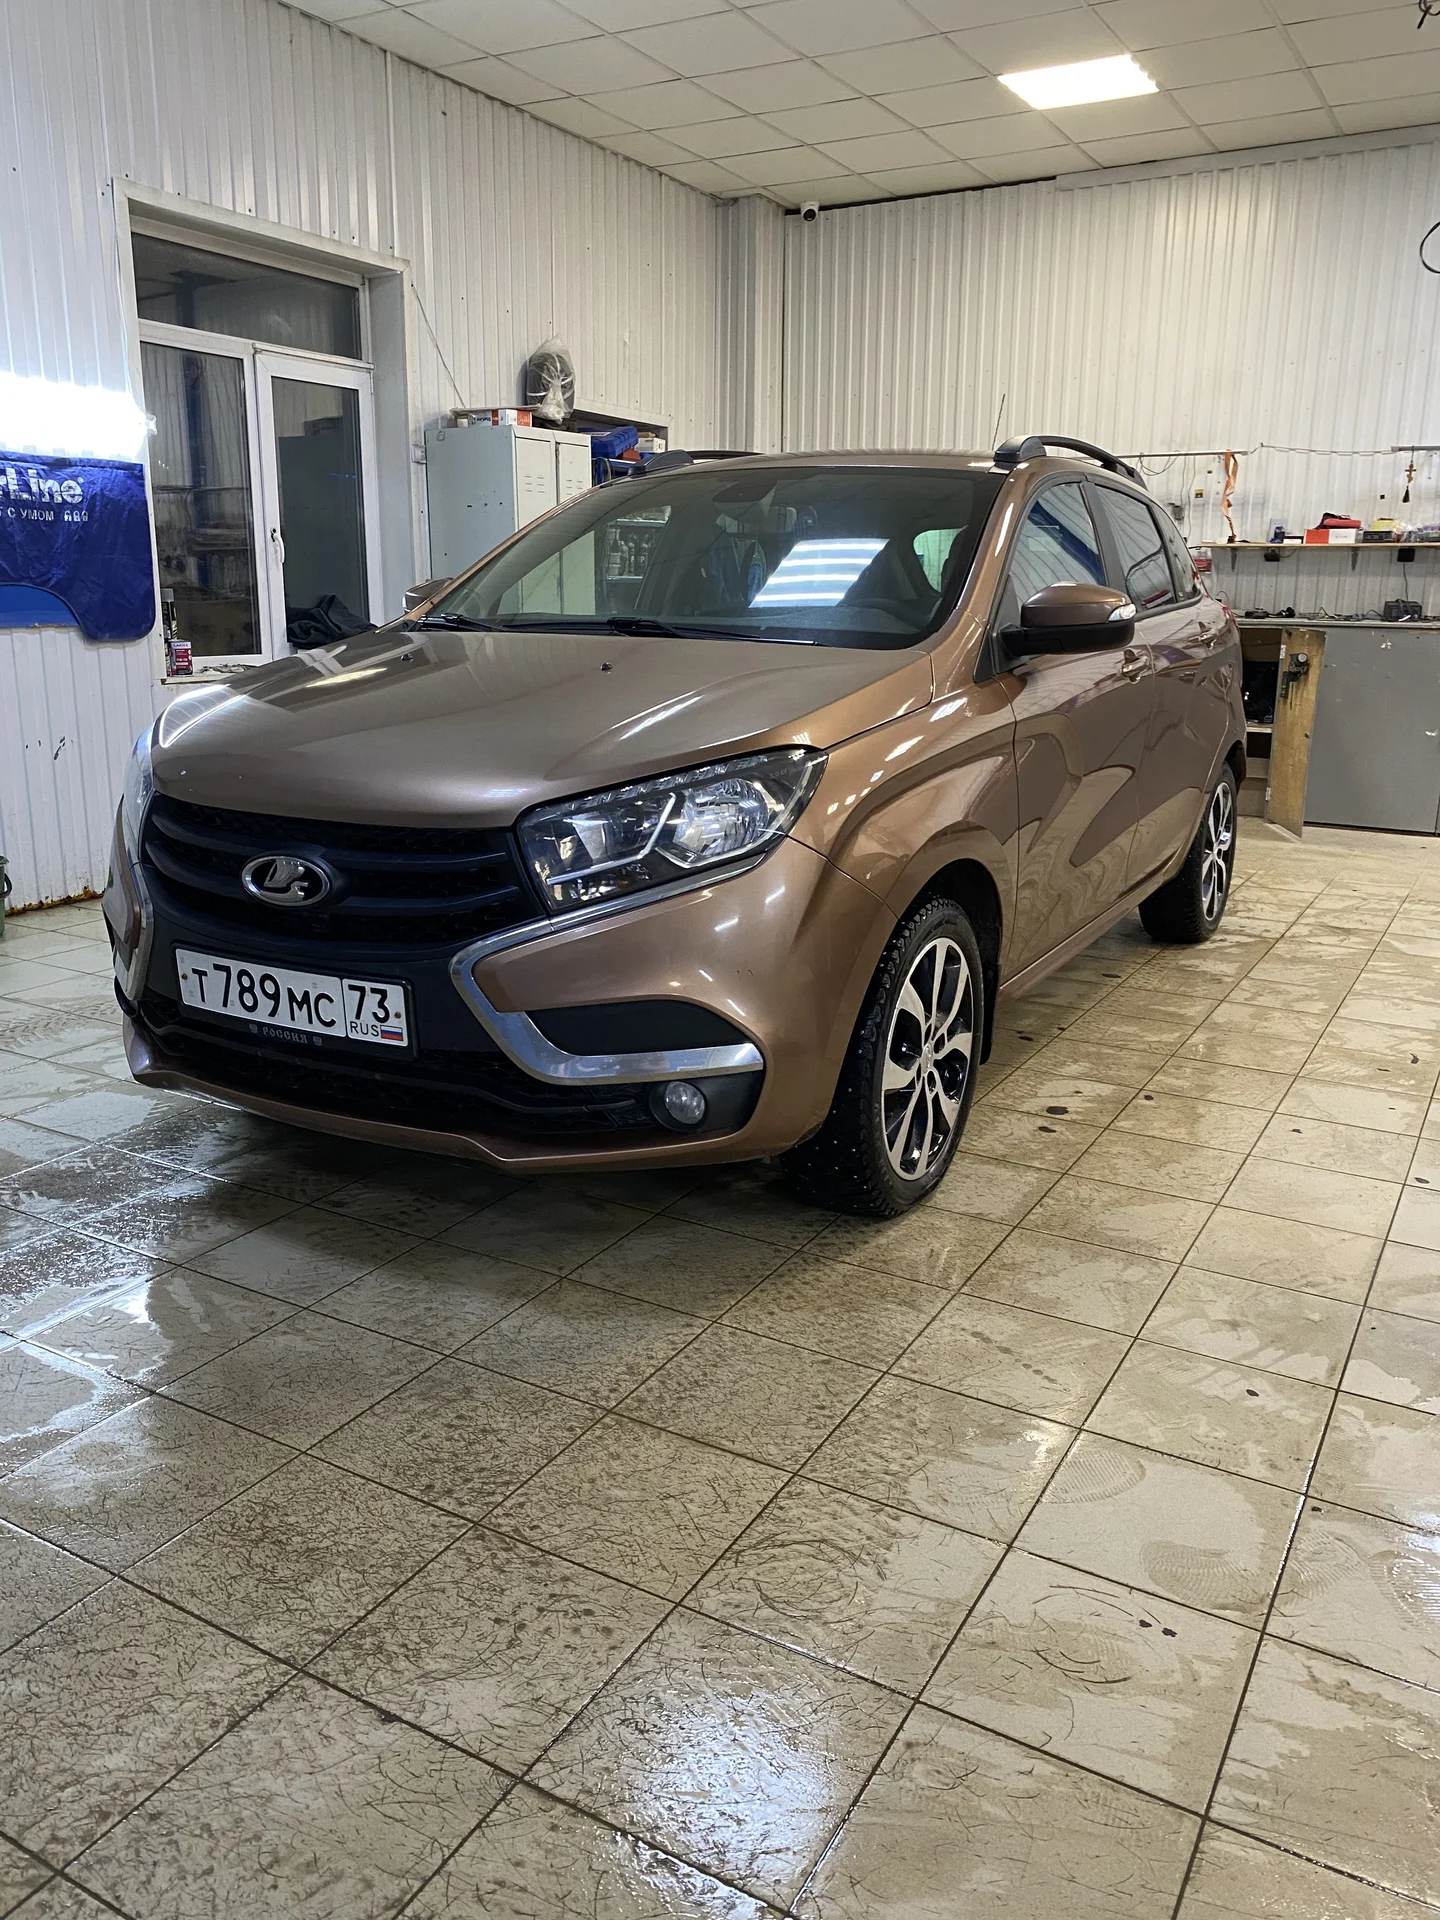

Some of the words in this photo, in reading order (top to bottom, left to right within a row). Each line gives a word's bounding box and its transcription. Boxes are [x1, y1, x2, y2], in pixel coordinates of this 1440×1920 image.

[20, 508, 54, 521] УМОМ
[348, 984, 390, 1024] 73
[262, 1026, 308, 1044] РОССИЯ
[350, 1021, 380, 1037] RUS
